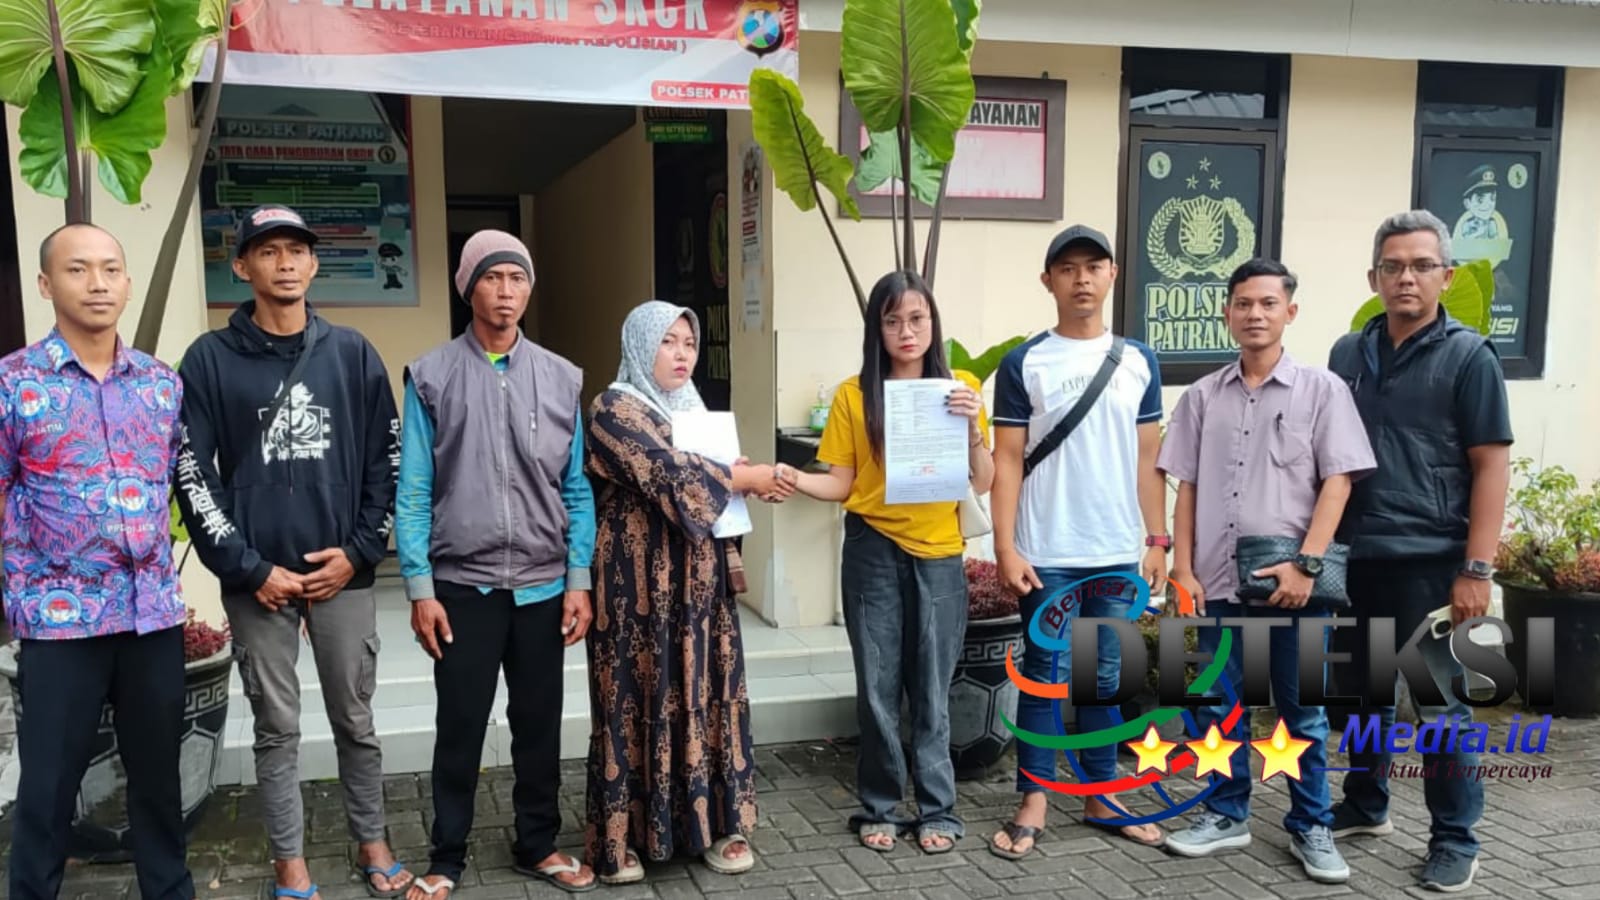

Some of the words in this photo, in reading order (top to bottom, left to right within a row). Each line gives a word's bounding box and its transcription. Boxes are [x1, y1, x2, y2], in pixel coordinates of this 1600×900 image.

[594, 0, 708, 30] SKCK
[657, 86, 714, 99] POLSEK
[719, 88, 750, 100] PAT
[966, 102, 1039, 126] AYANAN
[227, 121, 296, 136] POLSEK
[307, 126, 384, 139] PATRANG
[1148, 287, 1228, 318] POLSE
